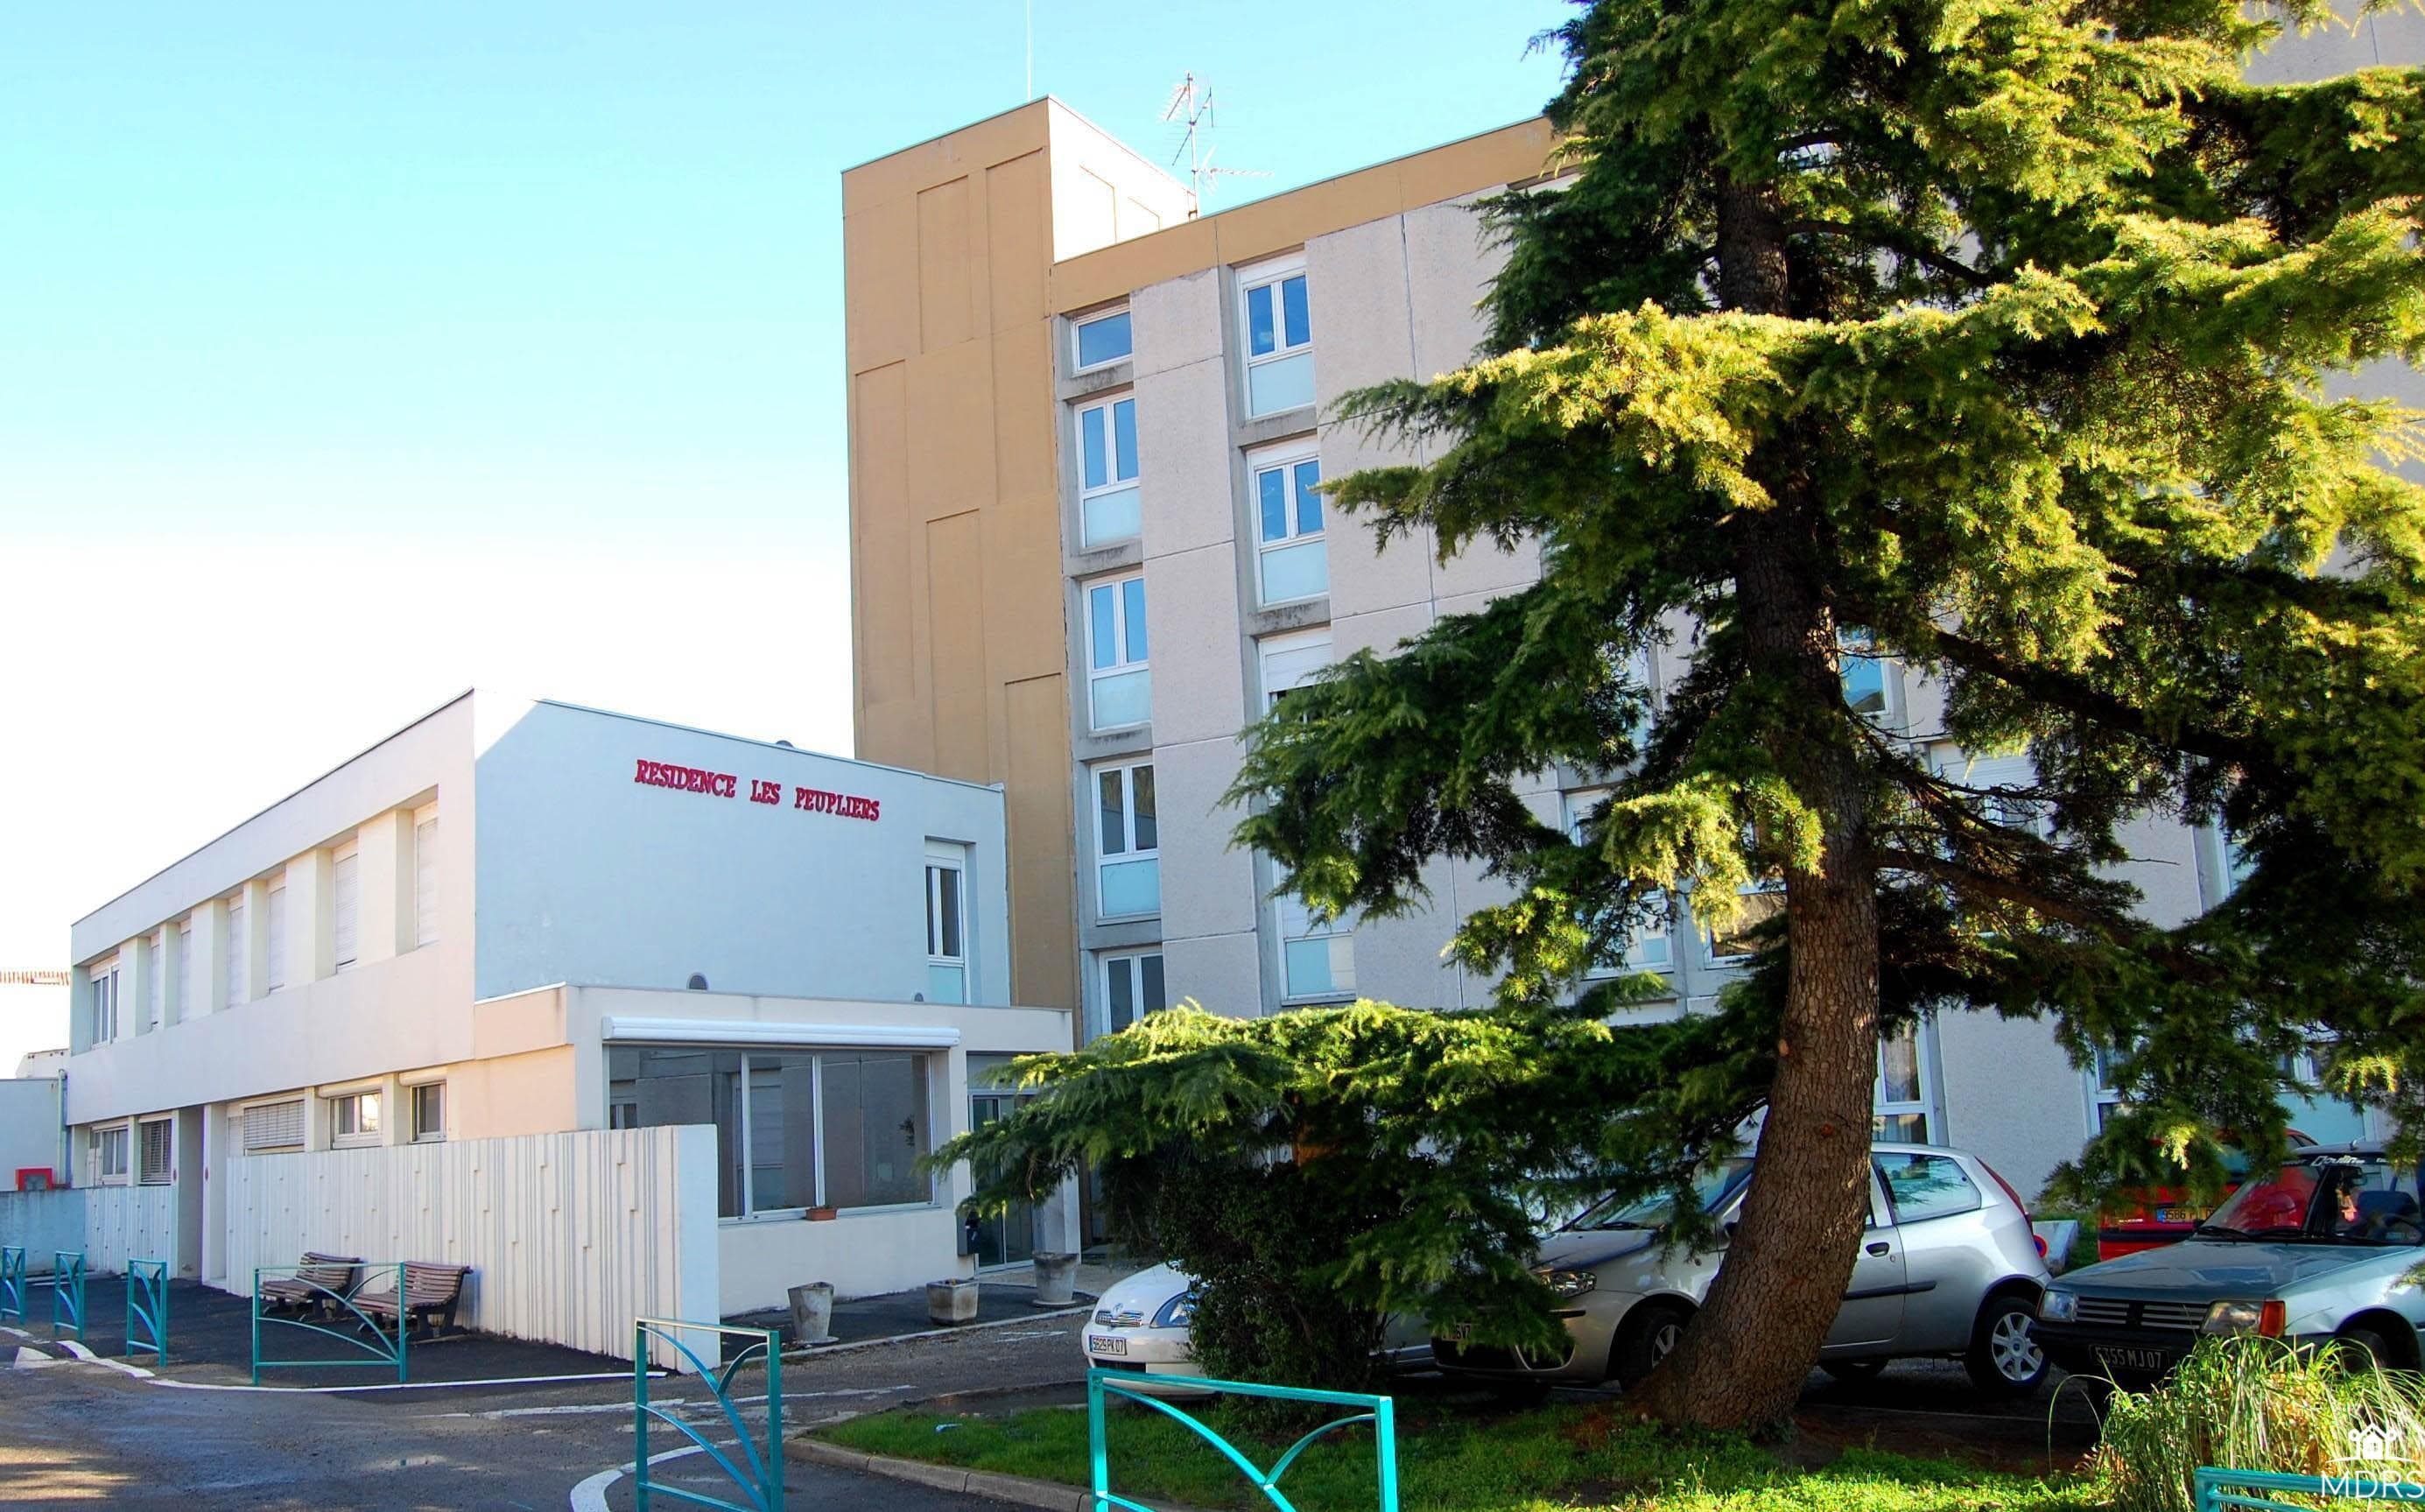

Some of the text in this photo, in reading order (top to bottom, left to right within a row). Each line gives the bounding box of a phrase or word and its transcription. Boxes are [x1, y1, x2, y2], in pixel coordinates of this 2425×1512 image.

[635, 759, 881, 821] RESIDENCE LES PEUPLIERS
